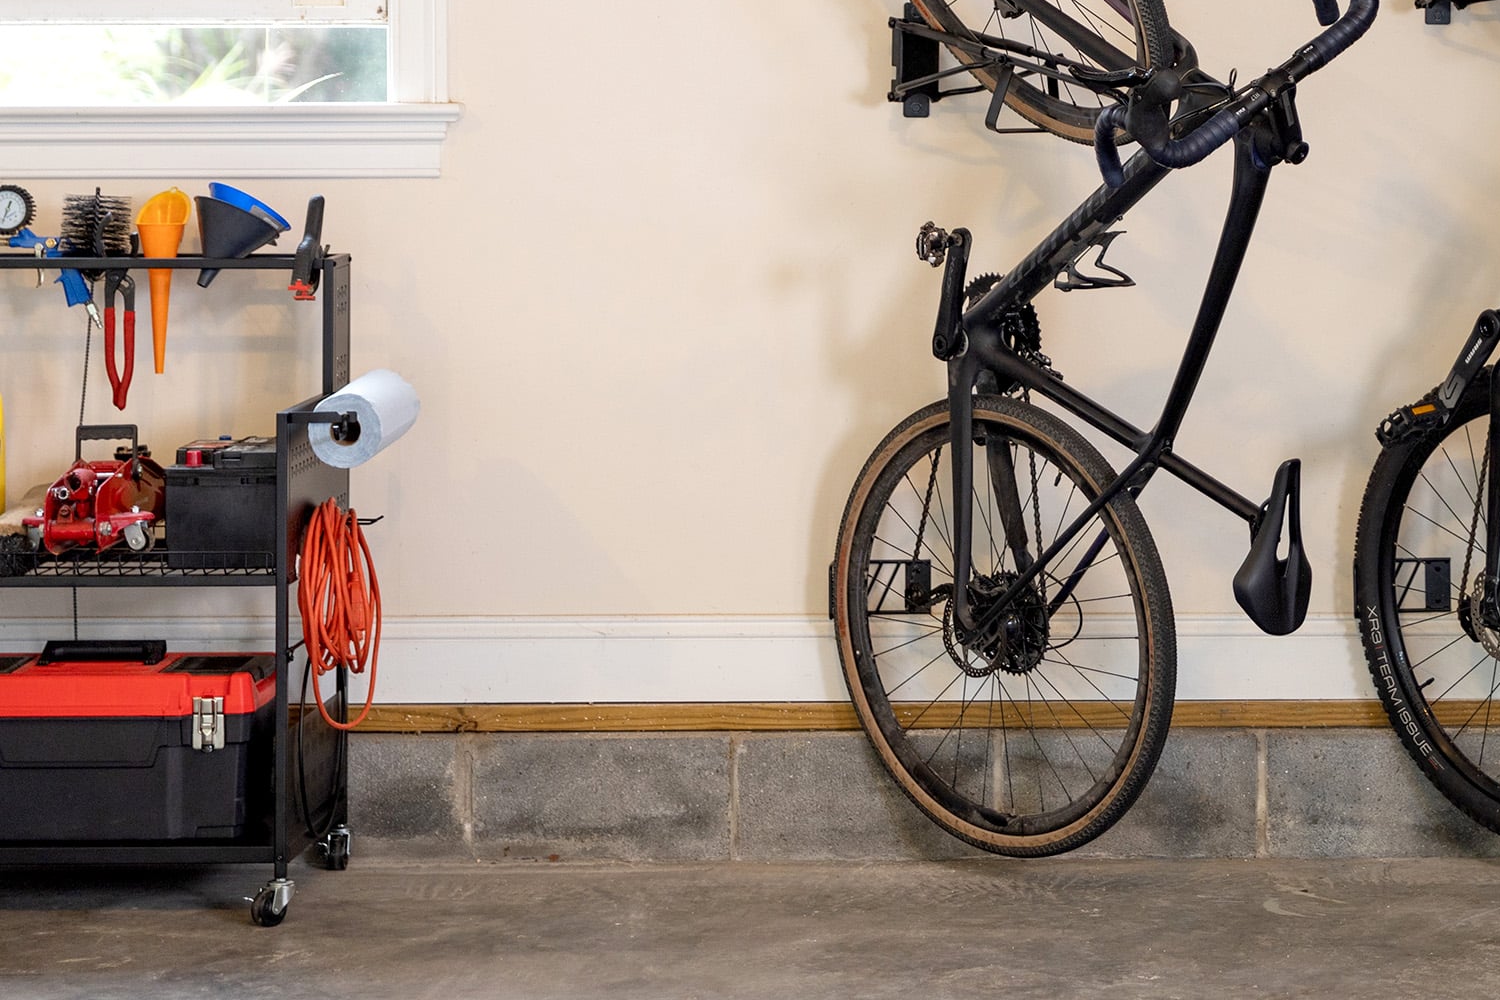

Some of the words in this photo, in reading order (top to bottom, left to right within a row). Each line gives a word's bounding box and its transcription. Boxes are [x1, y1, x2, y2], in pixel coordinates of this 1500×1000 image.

[1366, 605, 1383, 645] XR3
[1377, 651, 1402, 706] TEAM
[1397, 706, 1433, 756] ISSUE
